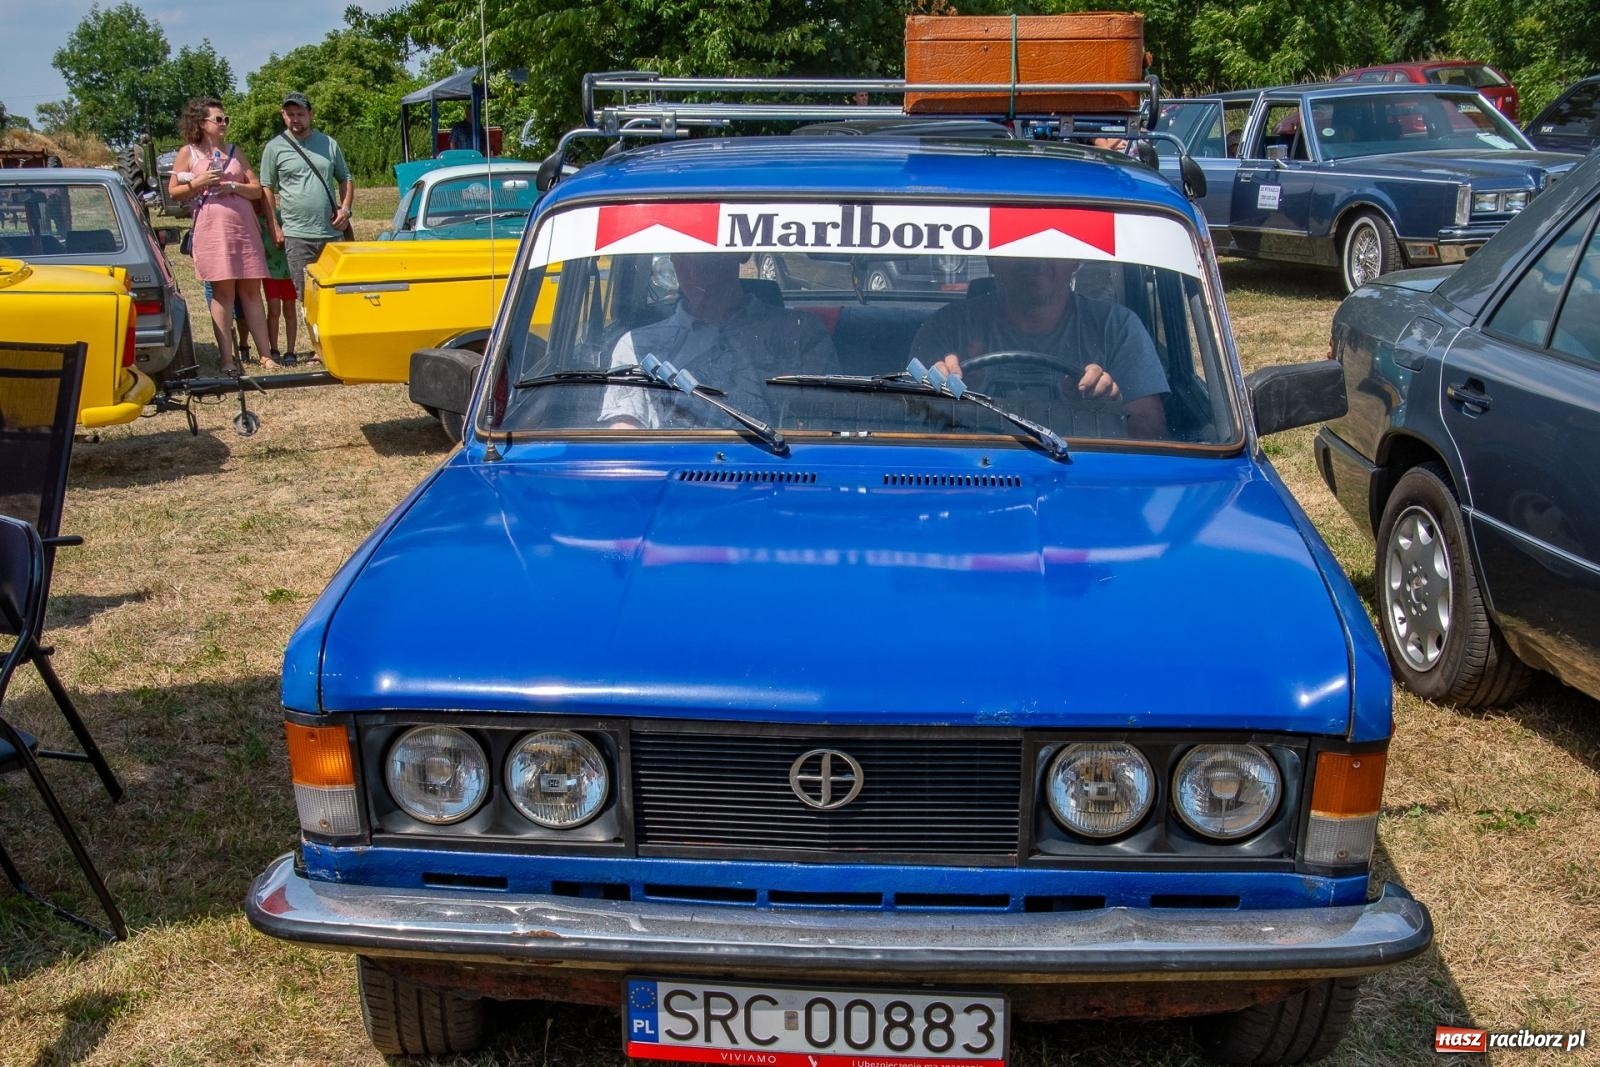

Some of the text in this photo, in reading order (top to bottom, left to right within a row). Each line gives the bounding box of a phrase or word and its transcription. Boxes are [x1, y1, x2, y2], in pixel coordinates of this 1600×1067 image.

[725, 204, 984, 251] Marlboro
[633, 1019, 655, 1034] PL
[663, 989, 997, 1055] SRC 00883
[720, 1052, 777, 1064] VIVIAMO
